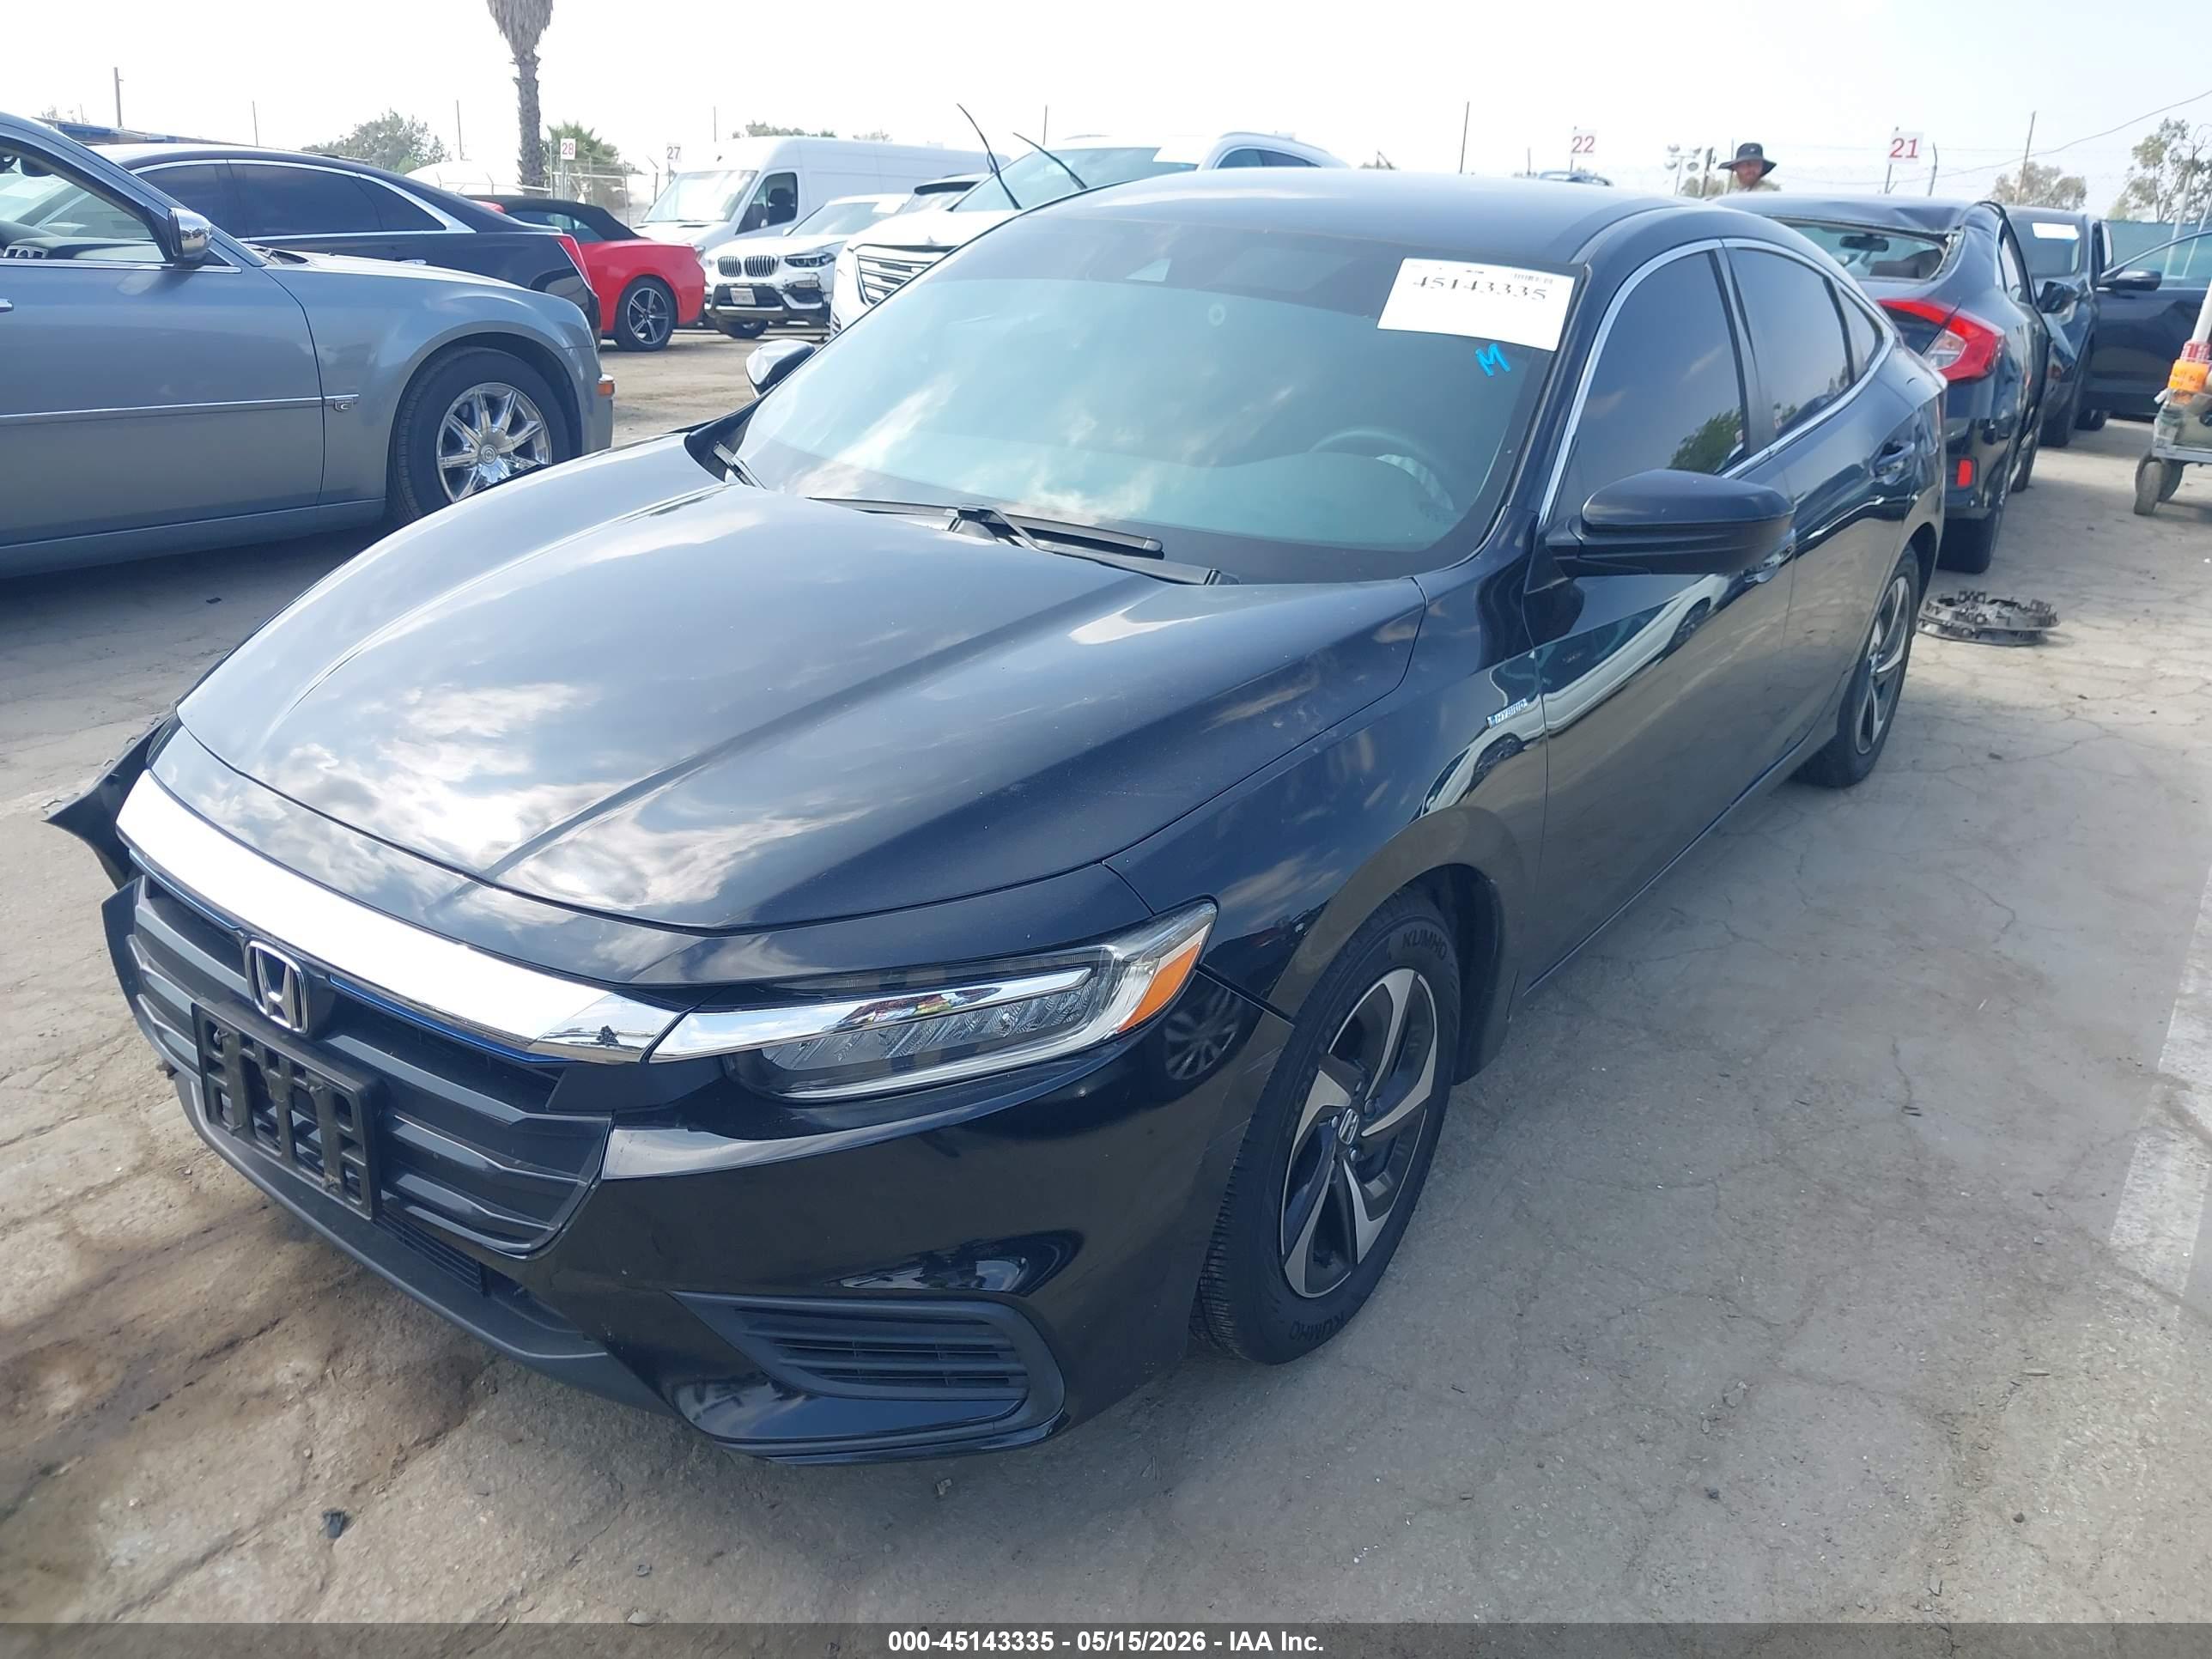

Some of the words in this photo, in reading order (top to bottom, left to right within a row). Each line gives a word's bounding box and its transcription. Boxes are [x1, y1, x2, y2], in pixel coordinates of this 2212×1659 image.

[562, 143, 574, 155] 28
[666, 146, 681, 160] 27
[1571, 136, 1595, 153] 22
[1889, 137, 1917, 158] 21
[1413, 276, 1547, 300] 45143335
[1475, 343, 1511, 377] M
[1401, 928, 1449, 961] KUMHO
